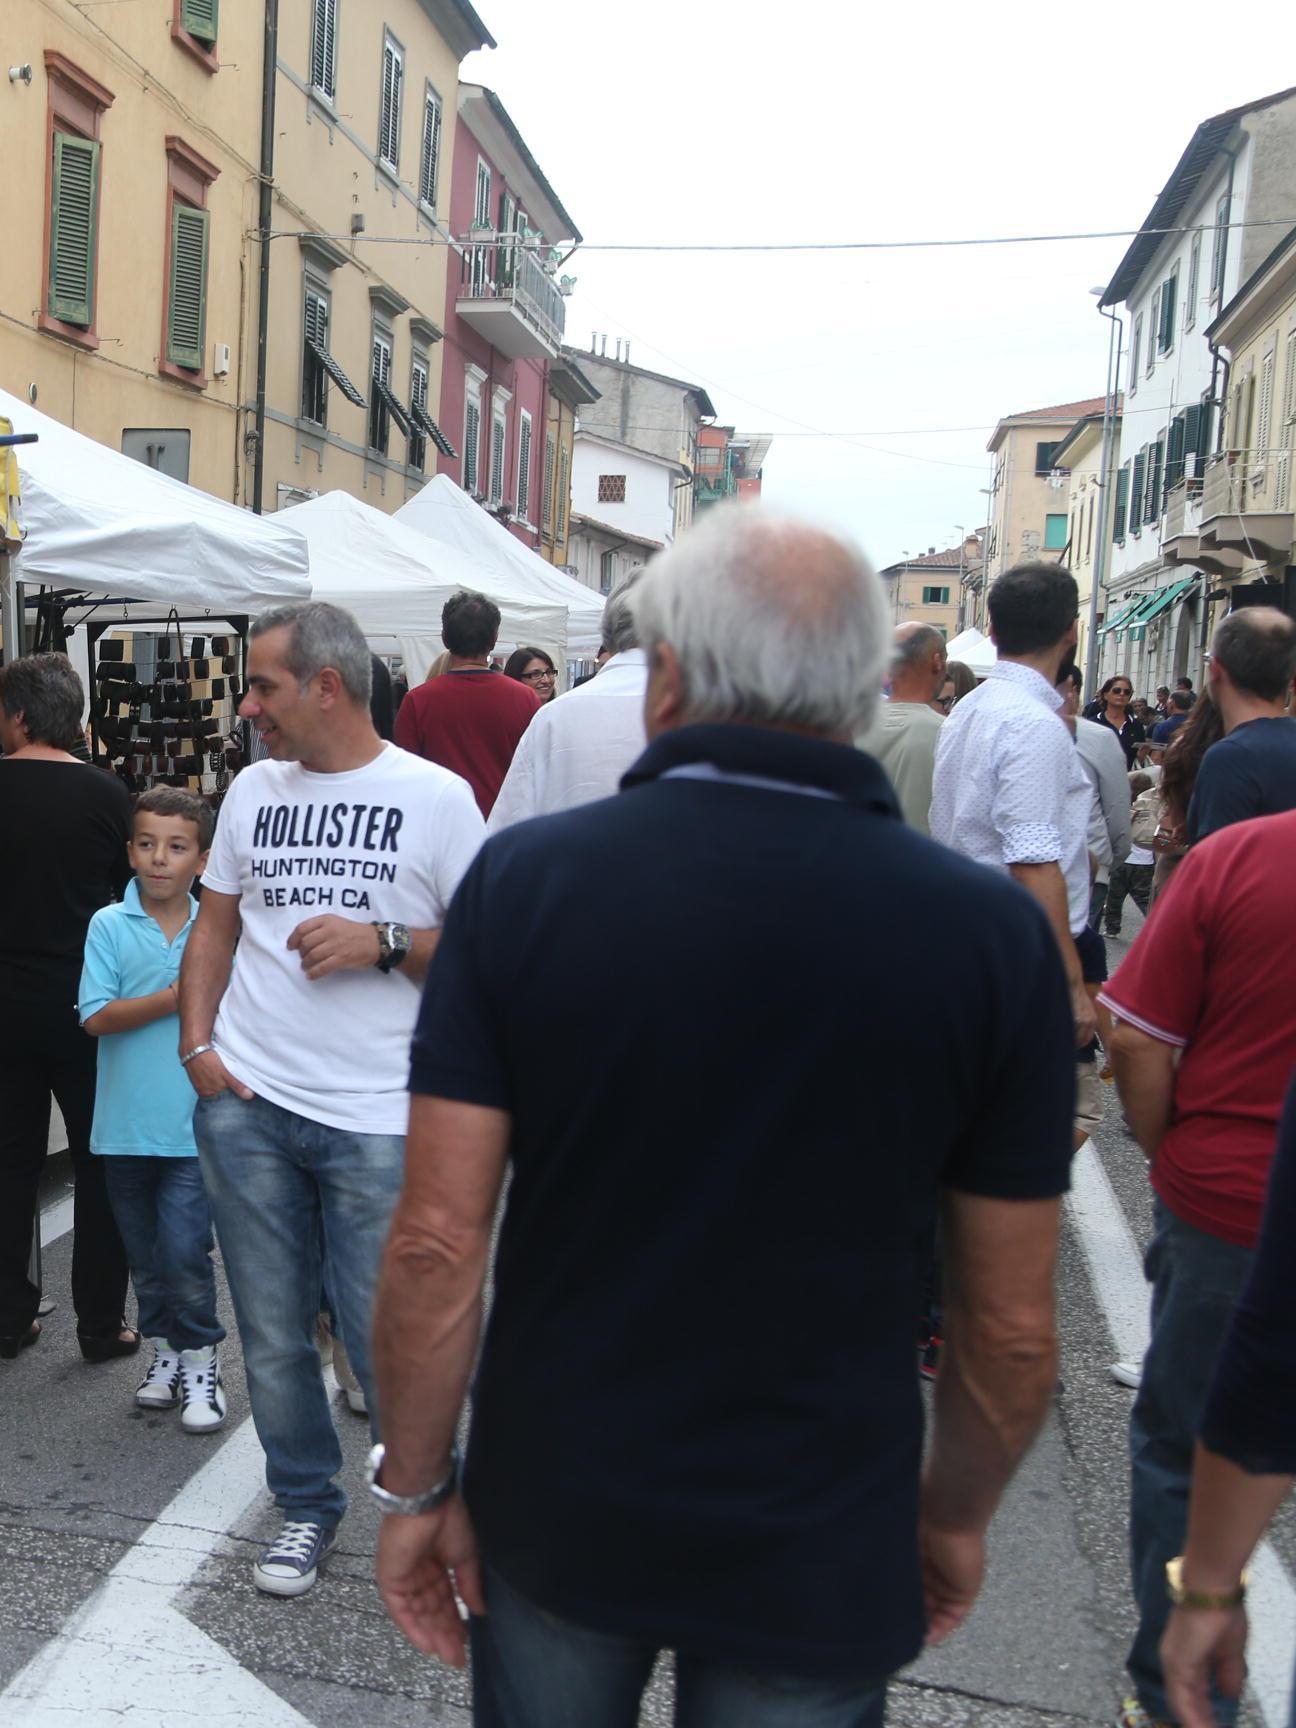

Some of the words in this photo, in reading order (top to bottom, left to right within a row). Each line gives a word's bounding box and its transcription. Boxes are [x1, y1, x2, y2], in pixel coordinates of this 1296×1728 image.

[253, 802, 404, 852] HOLLISTER
[252, 857, 397, 883] HUNTINGTON
[263, 887, 334, 908] BEACH
[341, 888, 371, 910] CA
